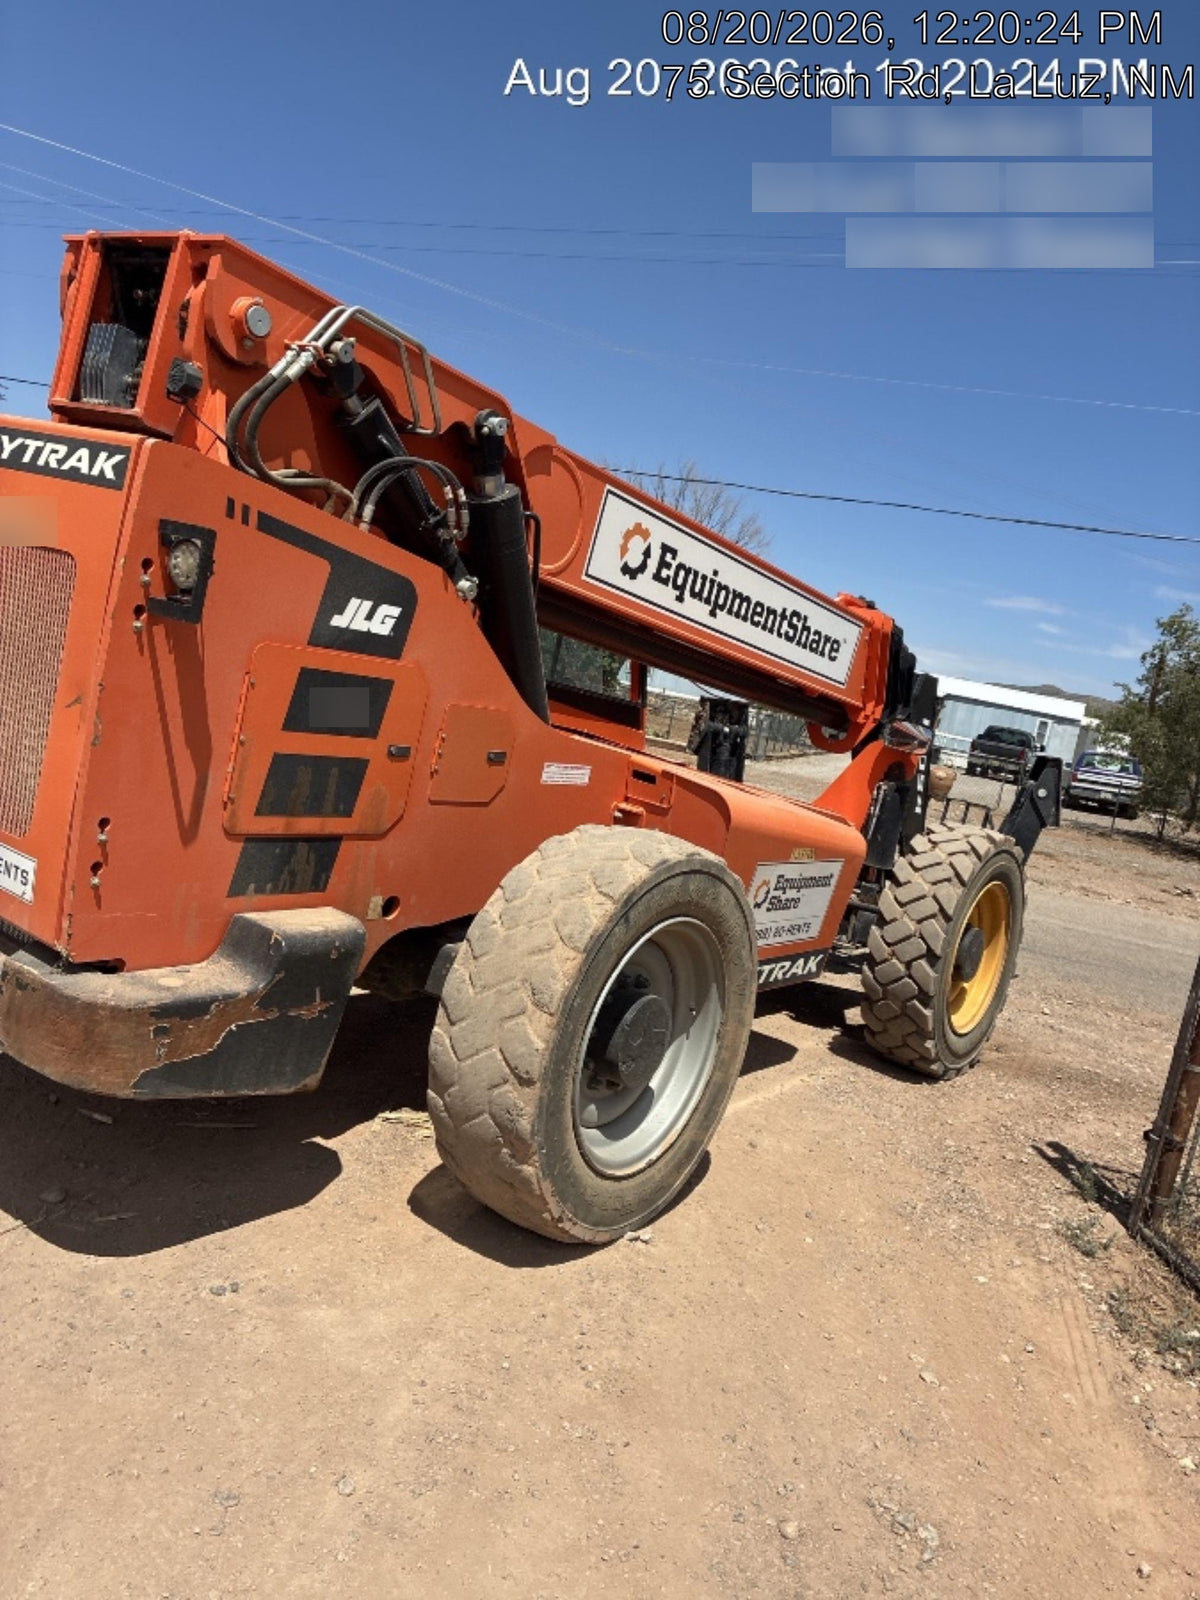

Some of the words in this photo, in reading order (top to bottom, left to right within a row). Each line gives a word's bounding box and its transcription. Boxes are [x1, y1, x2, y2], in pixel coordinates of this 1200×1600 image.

[329, 596, 403, 636] JLG
[652, 541, 842, 663] EquipmentShare
[773, 872, 834, 895] Equipment
[766, 895, 801, 912] Share
